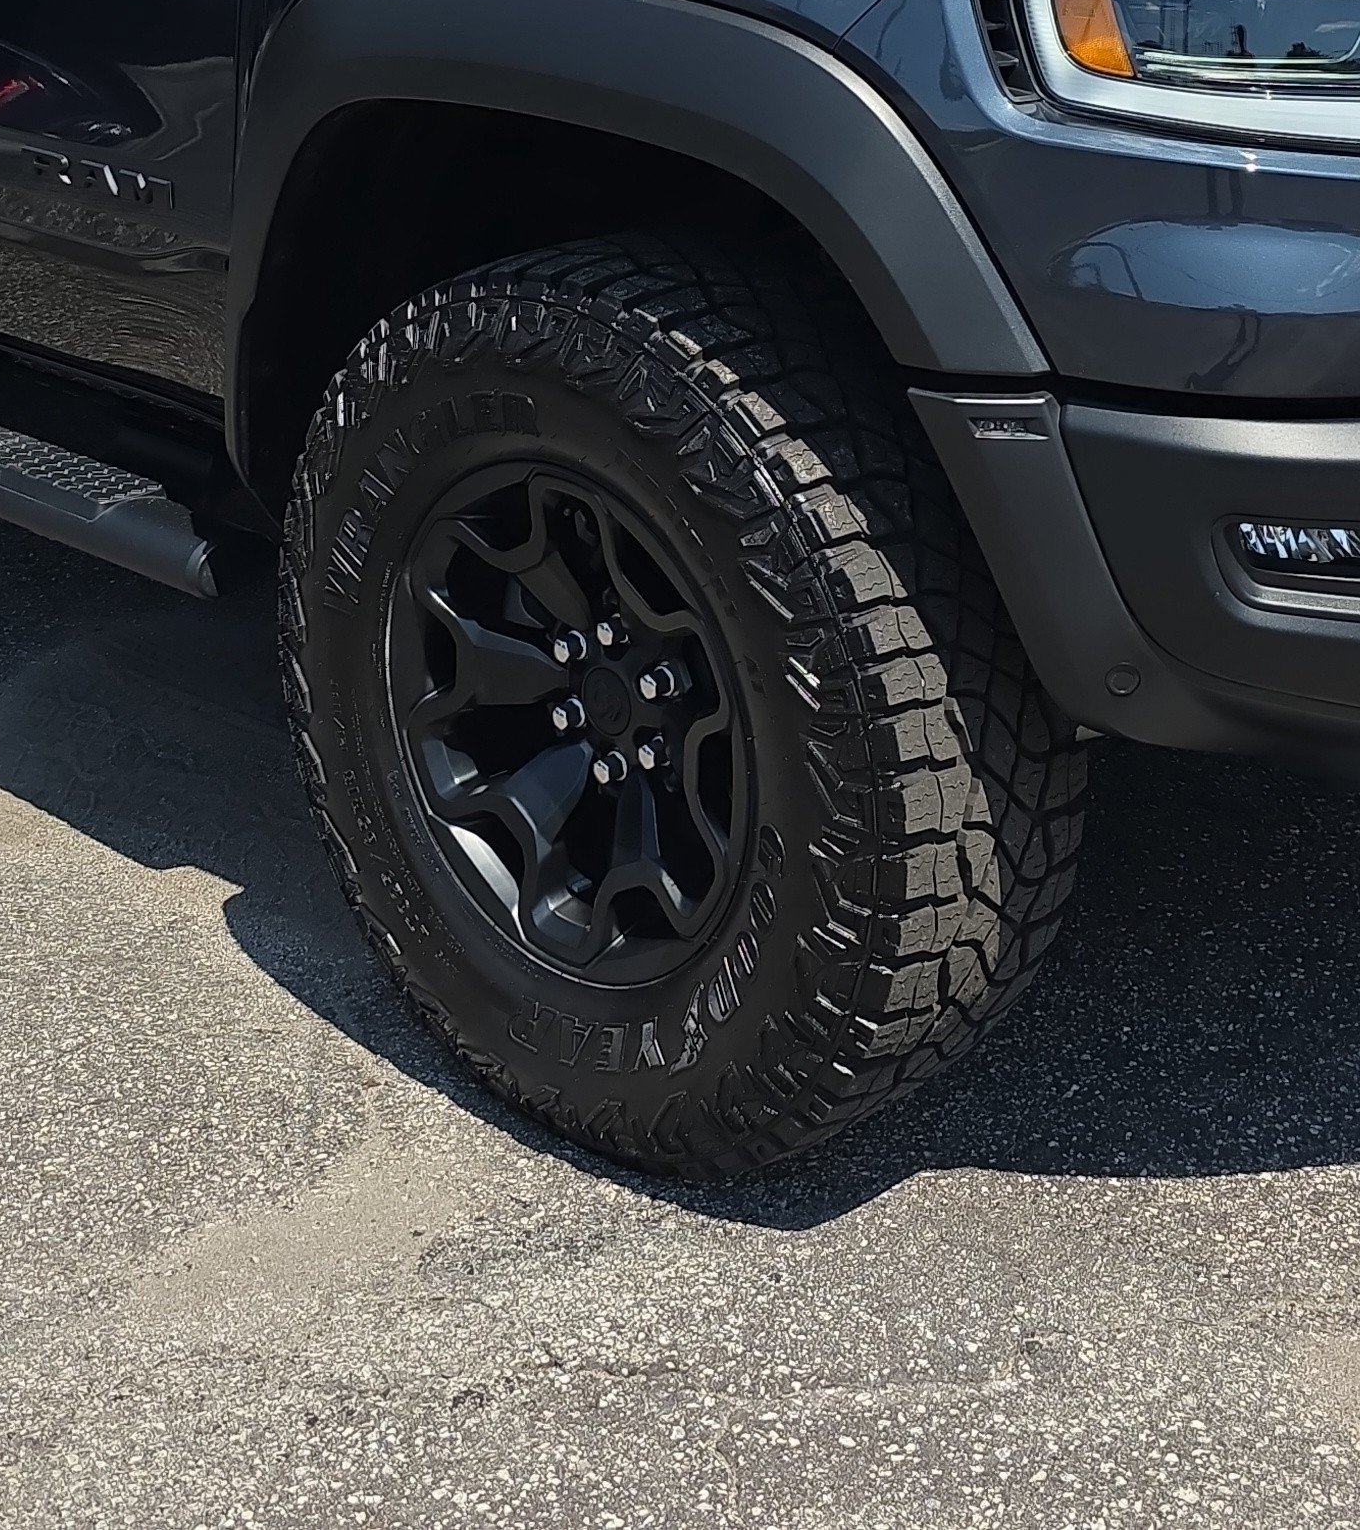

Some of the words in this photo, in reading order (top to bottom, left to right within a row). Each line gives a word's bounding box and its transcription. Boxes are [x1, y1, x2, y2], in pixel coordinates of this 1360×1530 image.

[20, 144, 175, 211] RAM
[323, 388, 542, 616] WRANGLER
[508, 823, 787, 1076] GOODYEAR
